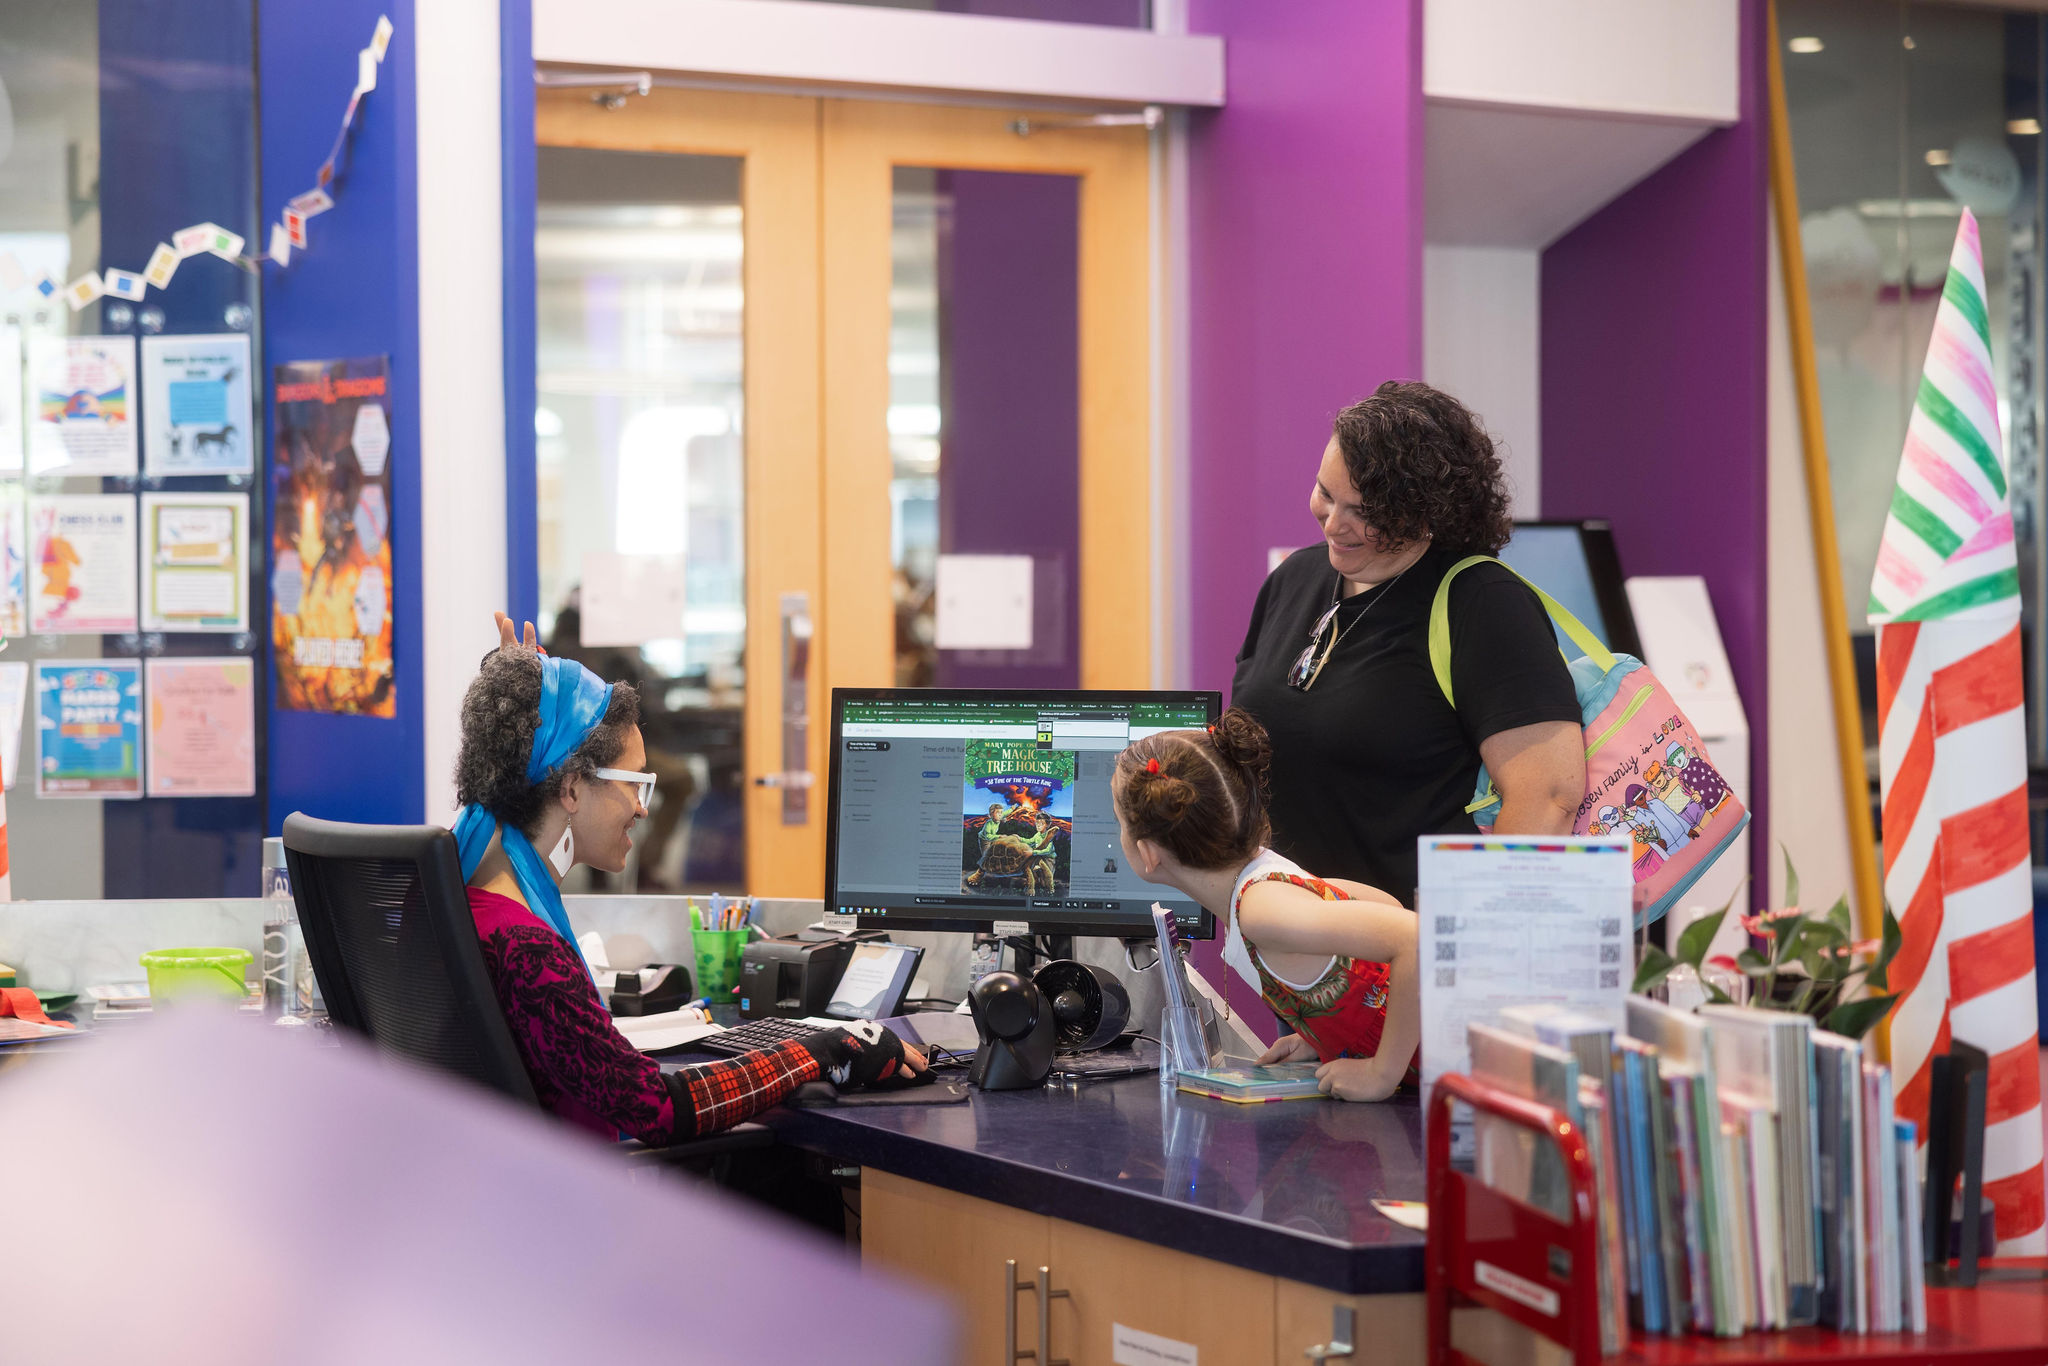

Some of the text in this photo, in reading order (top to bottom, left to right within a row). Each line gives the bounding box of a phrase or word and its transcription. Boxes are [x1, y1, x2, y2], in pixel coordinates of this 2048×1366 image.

[1002, 748, 1038, 760] MAGIC
[1640, 743, 1653, 755] is
[986, 760, 1052, 775] TREE HOUSE
